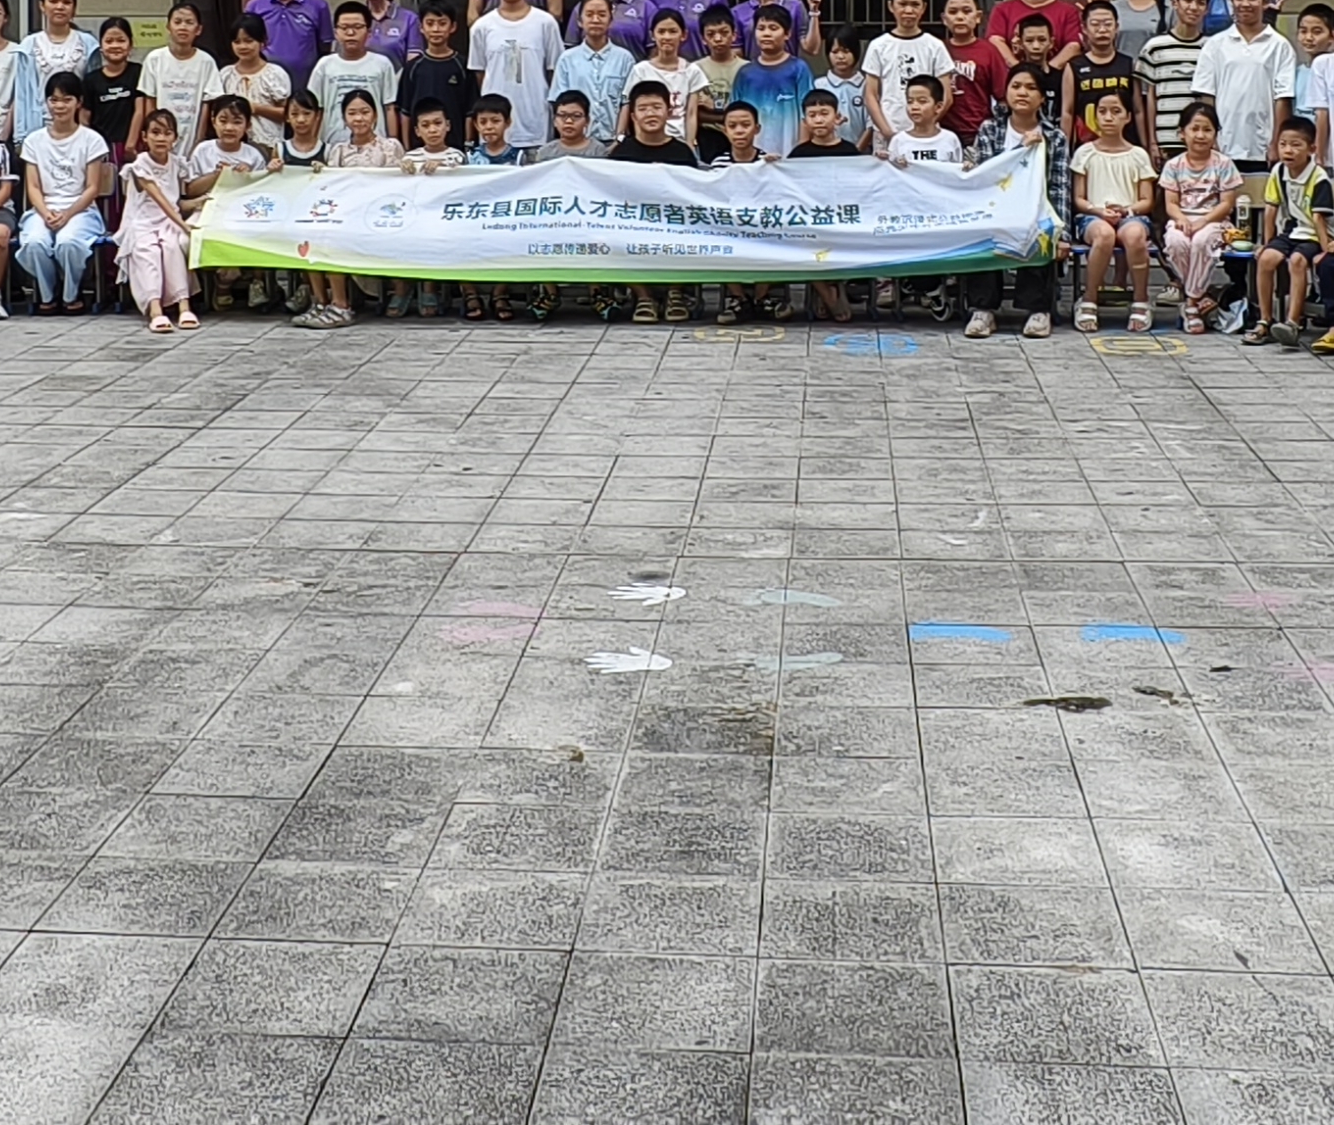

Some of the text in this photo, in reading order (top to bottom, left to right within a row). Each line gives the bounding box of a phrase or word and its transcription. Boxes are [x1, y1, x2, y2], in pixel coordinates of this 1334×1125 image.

[441, 195, 861, 228] 乐东县国际人才志愿者英语支教公益课
[519, 220, 582, 230] International
[528, 243, 733, 255] 以志愿传递爱心 让孩子听见世界声音
